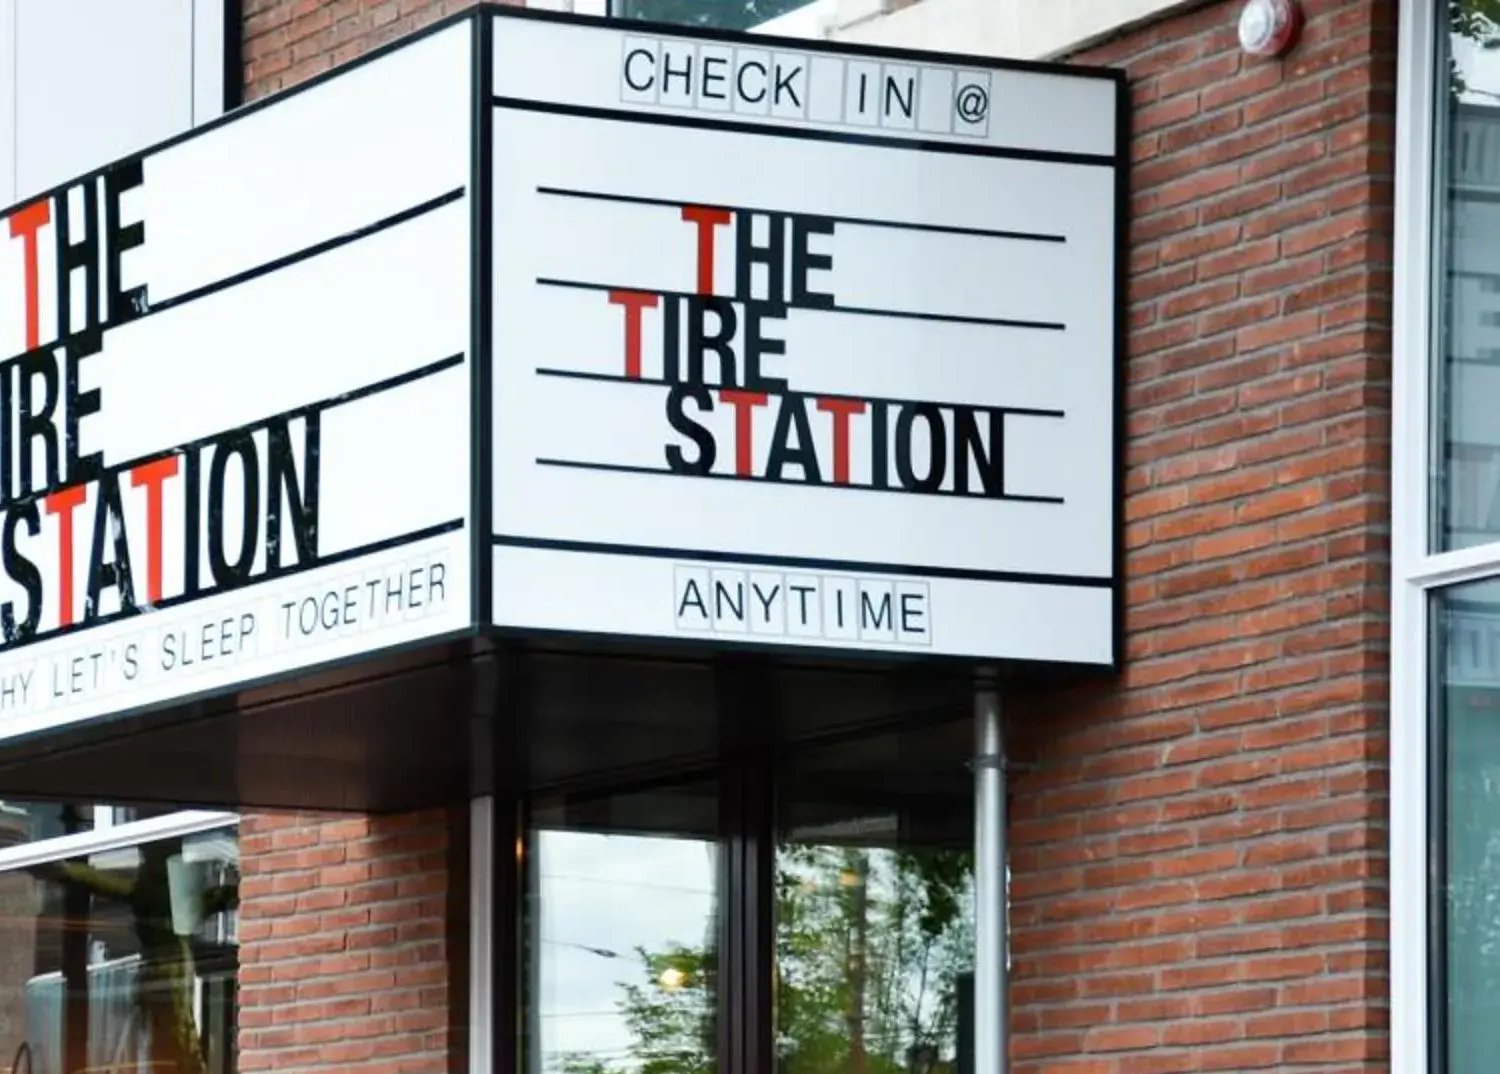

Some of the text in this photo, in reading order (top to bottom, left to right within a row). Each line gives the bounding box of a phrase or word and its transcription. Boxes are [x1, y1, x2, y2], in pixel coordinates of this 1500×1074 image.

[624, 48, 990, 125] CHECK IN @
[9, 158, 150, 353] THE
[681, 206, 836, 307] THE
[608, 290, 789, 394] TIRE
[665, 385, 1005, 496] STATION
[0, 410, 323, 645] STATION
[53, 643, 139, 698] LET'S
[161, 612, 256, 672] SLEEP
[281, 561, 446, 640] TOGETHER
[678, 577, 927, 634] ANYTIME
